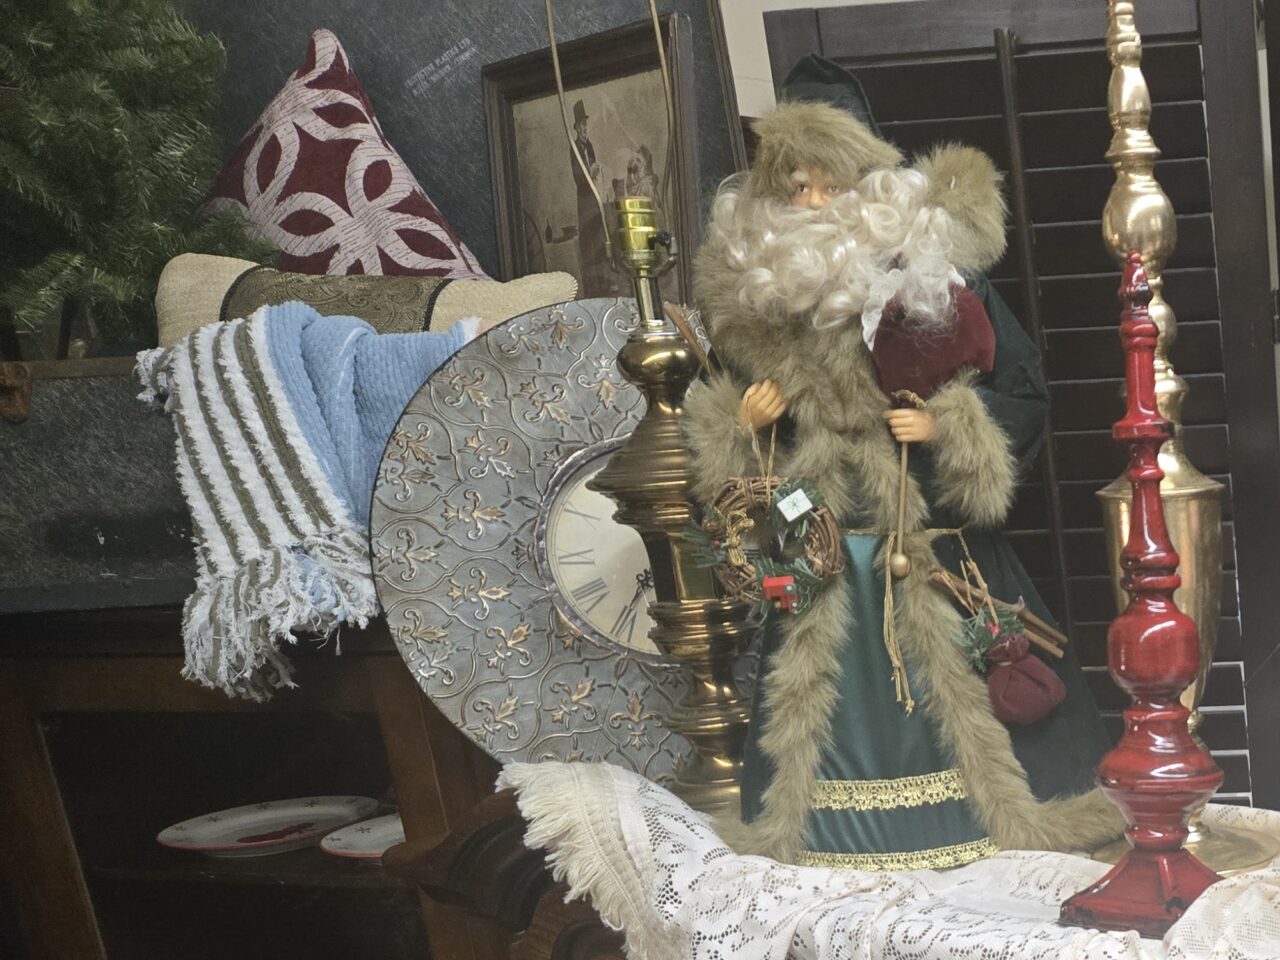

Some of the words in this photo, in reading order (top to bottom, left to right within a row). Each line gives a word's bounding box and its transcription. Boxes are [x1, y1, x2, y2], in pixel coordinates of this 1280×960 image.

[563, 501, 601, 530] X
[557, 547, 596, 566] IX
[571, 577, 611, 614] VIII
